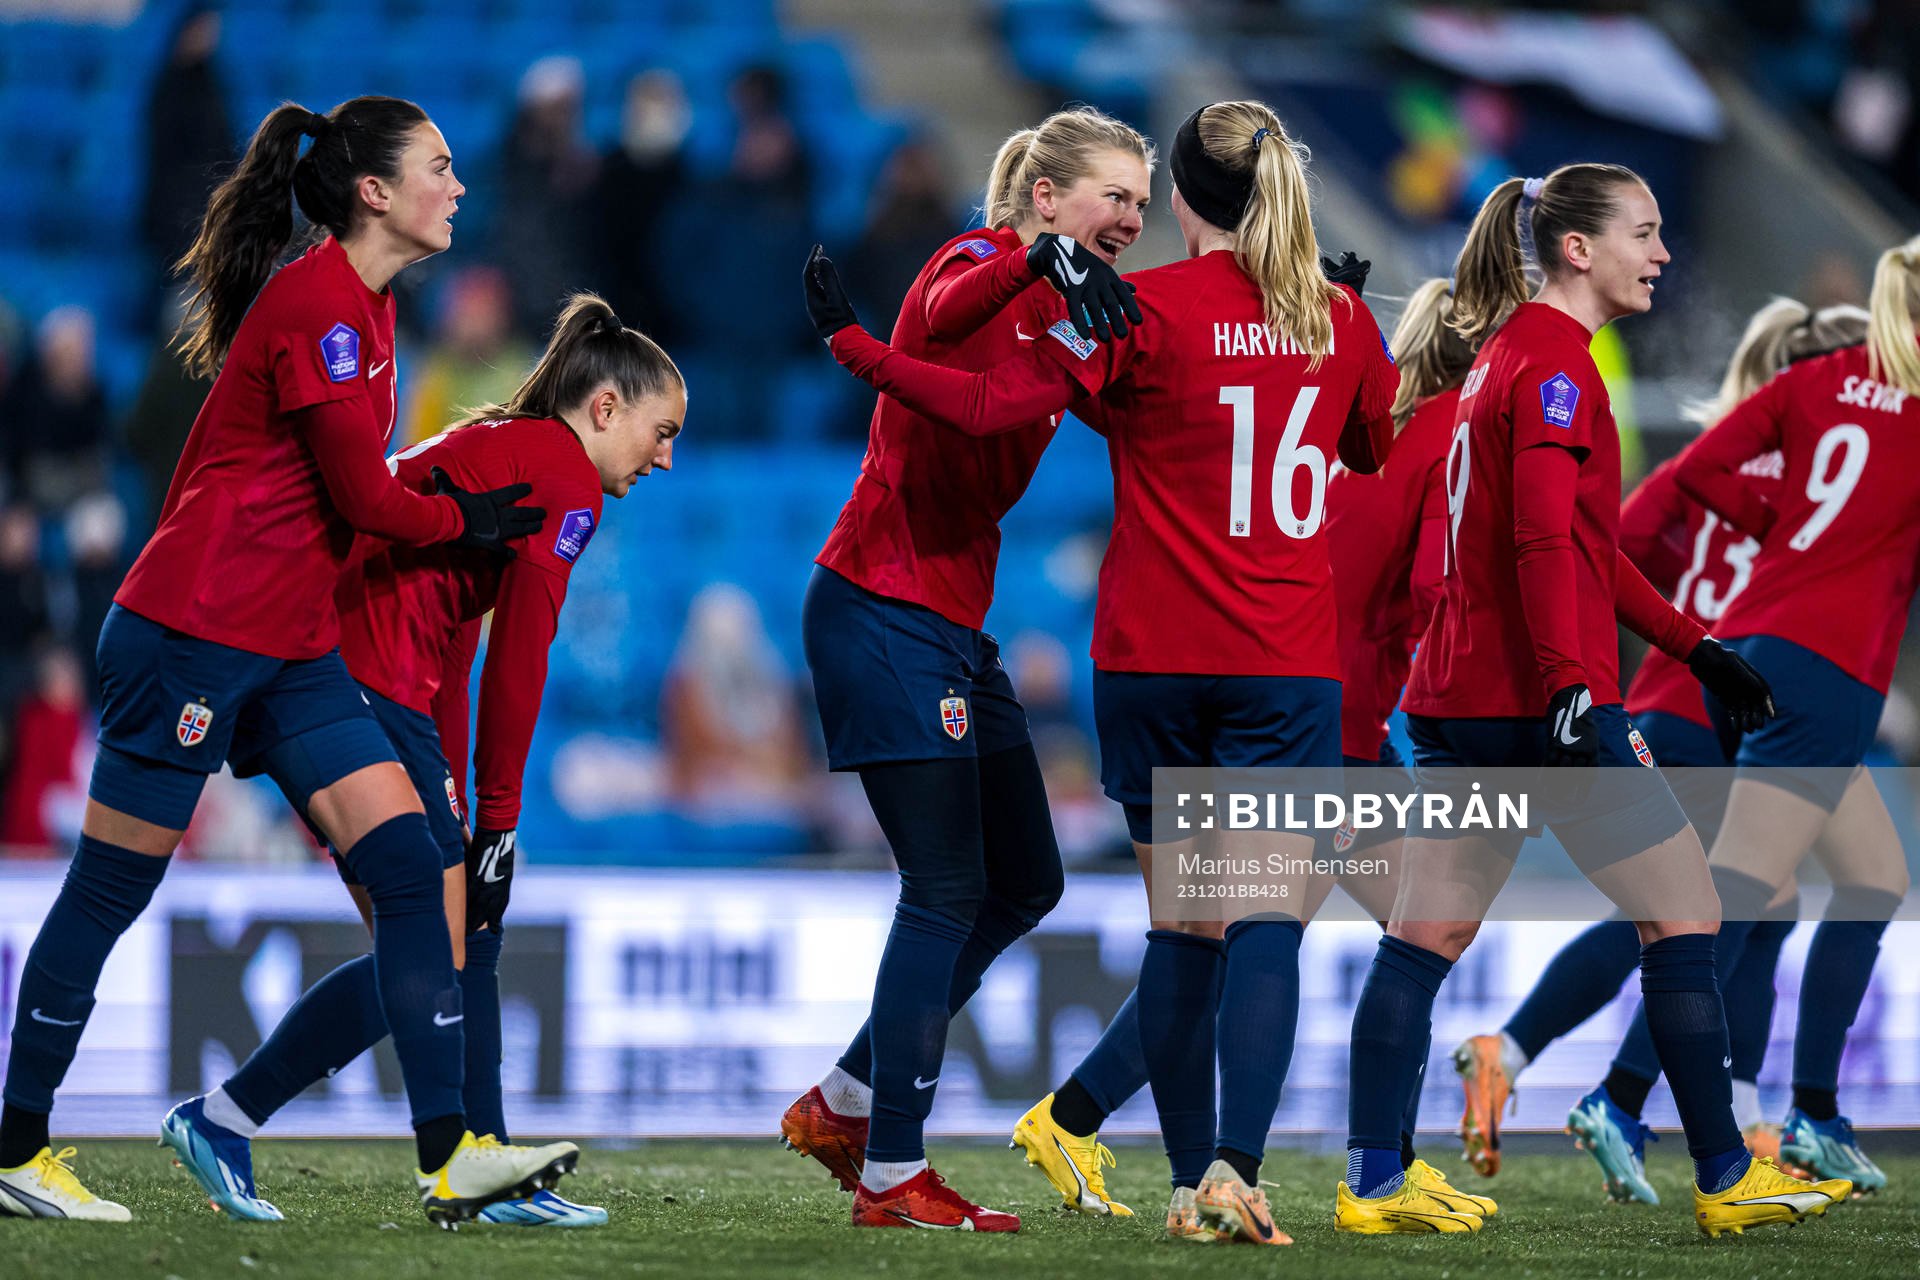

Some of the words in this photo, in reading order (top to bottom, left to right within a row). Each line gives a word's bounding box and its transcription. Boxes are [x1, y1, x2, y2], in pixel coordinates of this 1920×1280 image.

[1219, 386, 1327, 540] 16
[1443, 421, 1471, 576] 9
[1788, 423, 1870, 551] 9
